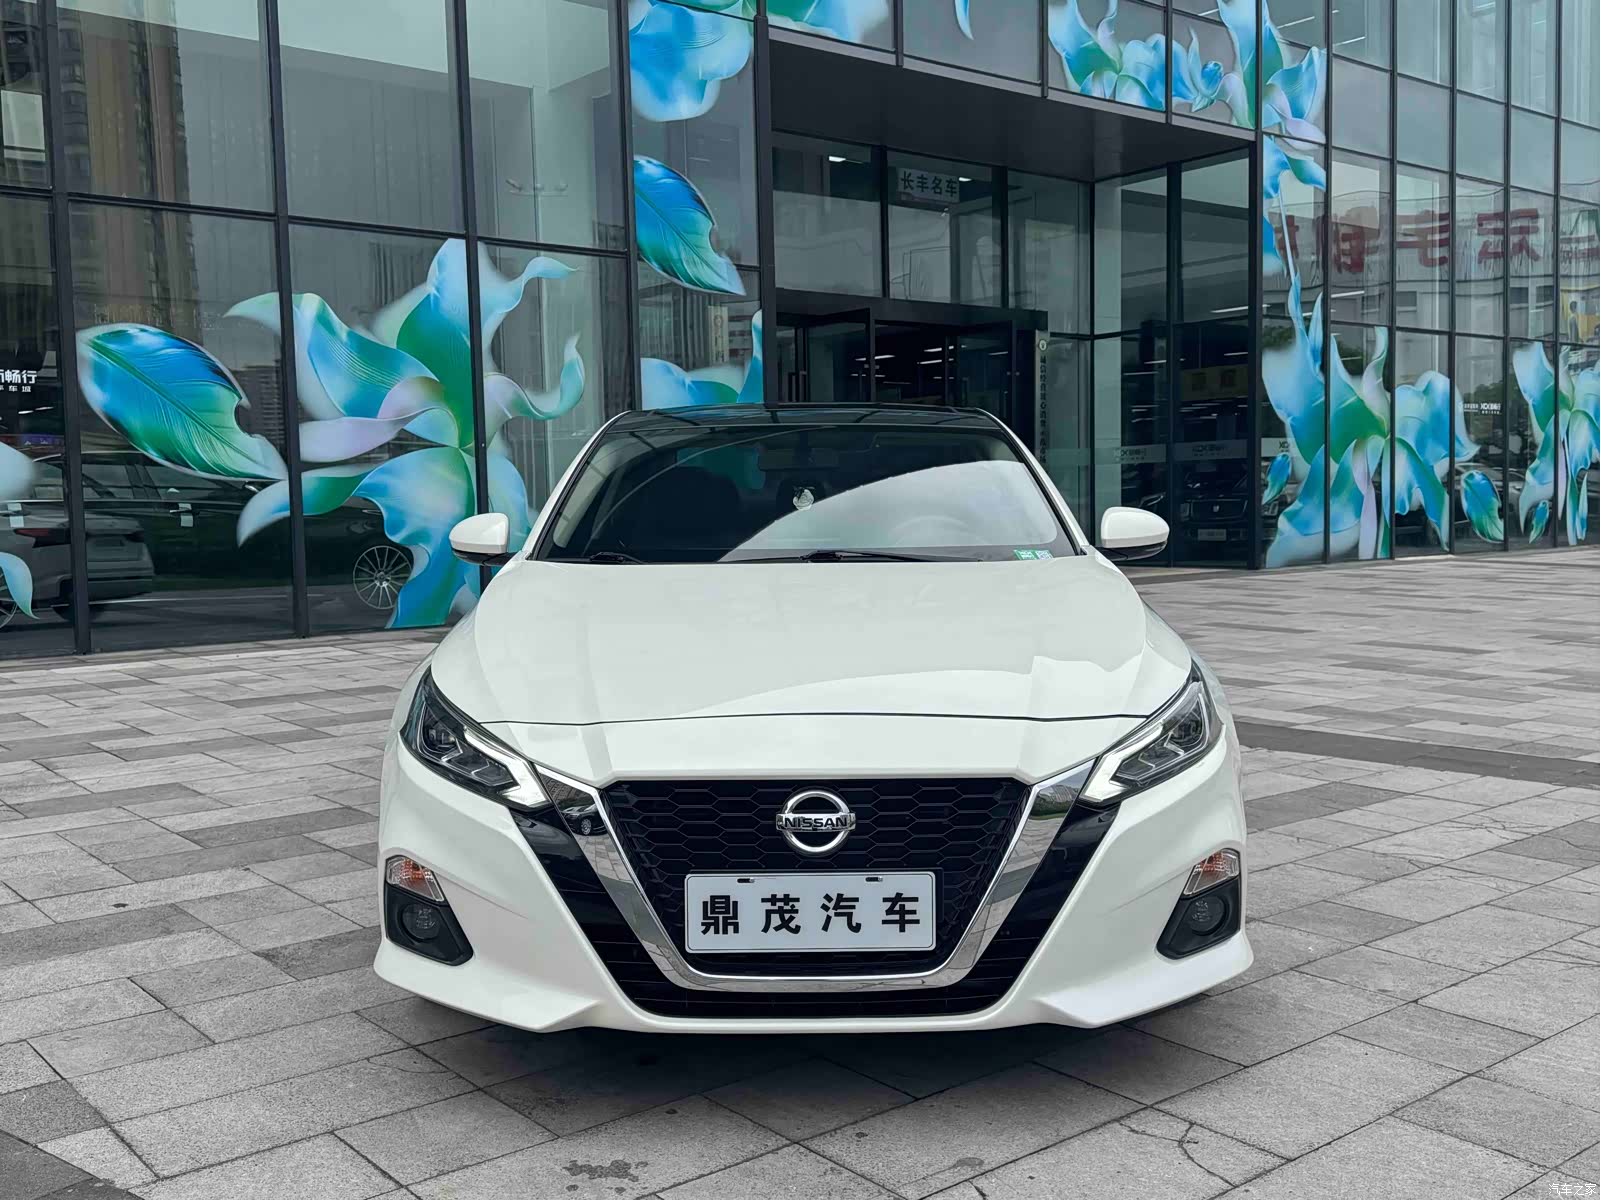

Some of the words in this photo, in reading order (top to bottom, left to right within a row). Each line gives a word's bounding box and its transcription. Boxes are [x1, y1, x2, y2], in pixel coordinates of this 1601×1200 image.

[901, 171, 957, 197] 长丰名车
[784, 817, 847, 828] NISSAN
[701, 892, 920, 935] 鼎茂汽车
